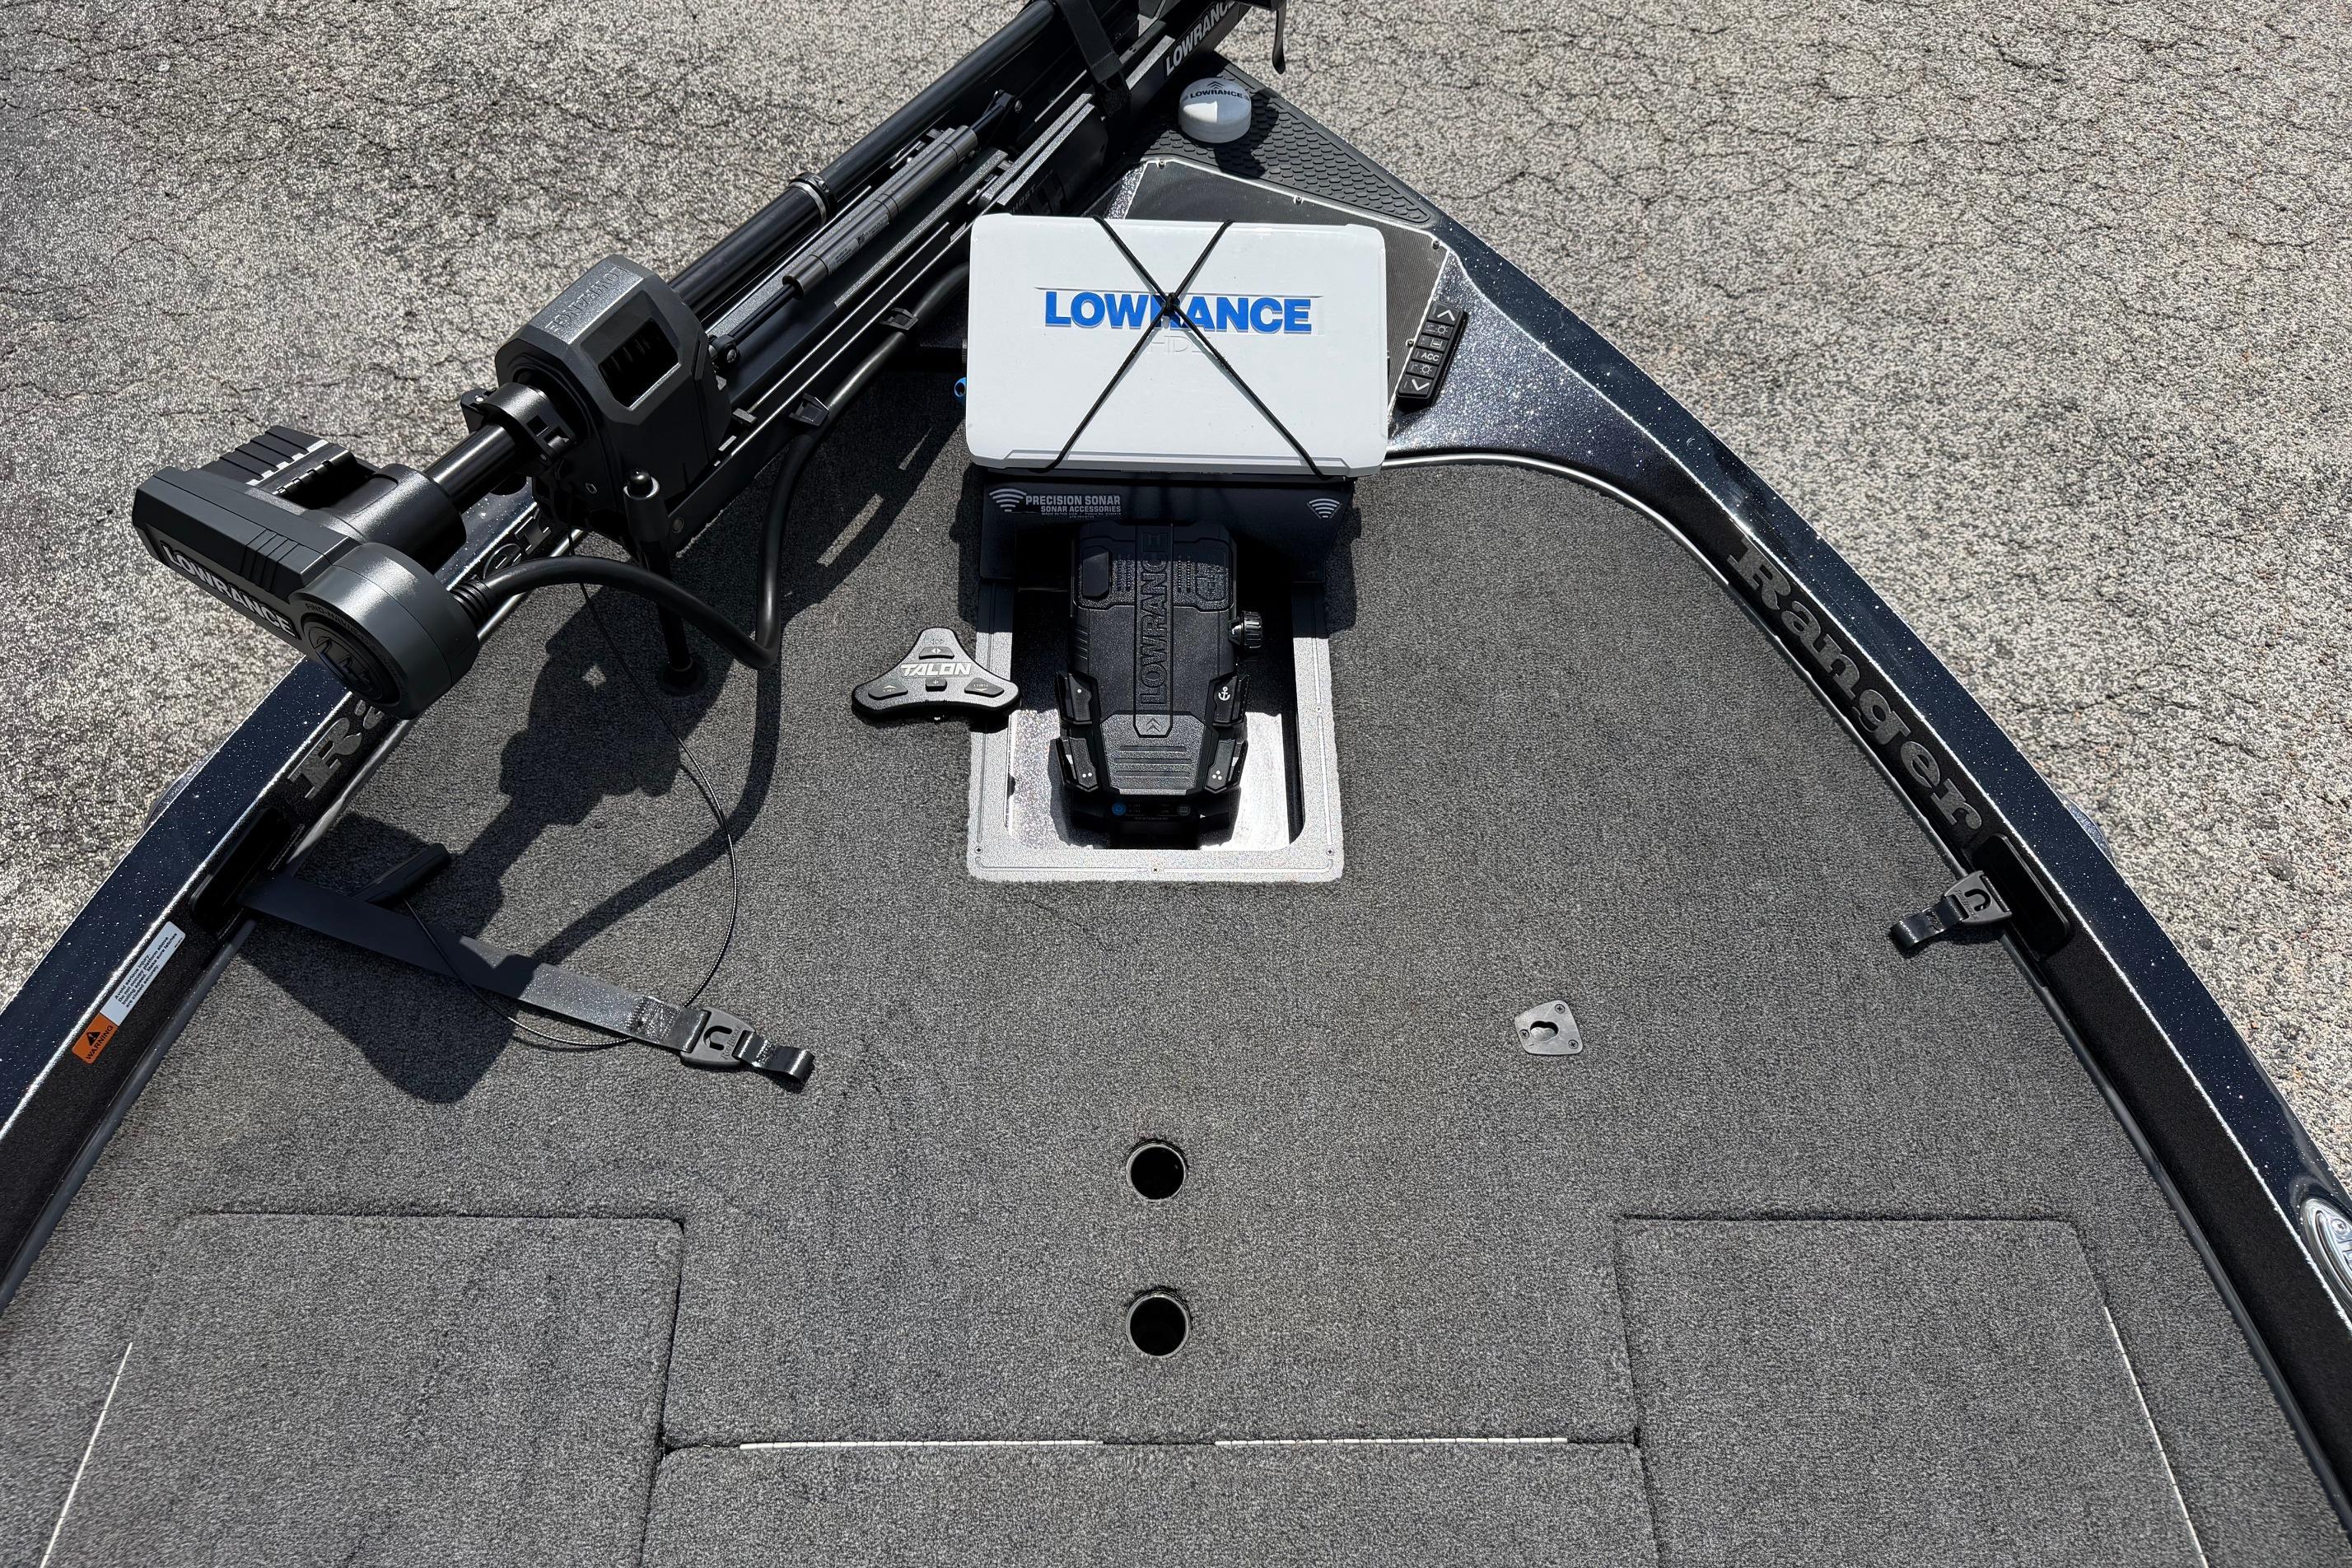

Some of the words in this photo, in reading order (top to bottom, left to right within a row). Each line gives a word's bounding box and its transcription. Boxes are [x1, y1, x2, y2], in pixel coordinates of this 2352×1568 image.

[1166, 0, 1235, 77] LOWRANC
[1190, 89, 1244, 99] LOWRANCE
[1044, 291, 1312, 334] LOWRANCE
[1420, 349, 1440, 362] ACC
[1025, 495, 1082, 506] PRECISION
[1085, 495, 1121, 506] SONAR
[161, 545, 299, 639] LOWRANCE
[1140, 531, 1169, 706] LOWRANCE
[900, 662, 973, 677] TALON
[1726, 536, 1983, 830] Ranger
[142, 950, 159, 970] platform
[124, 968, 139, 985] serious
[84, 1024, 114, 1060] WARNING
